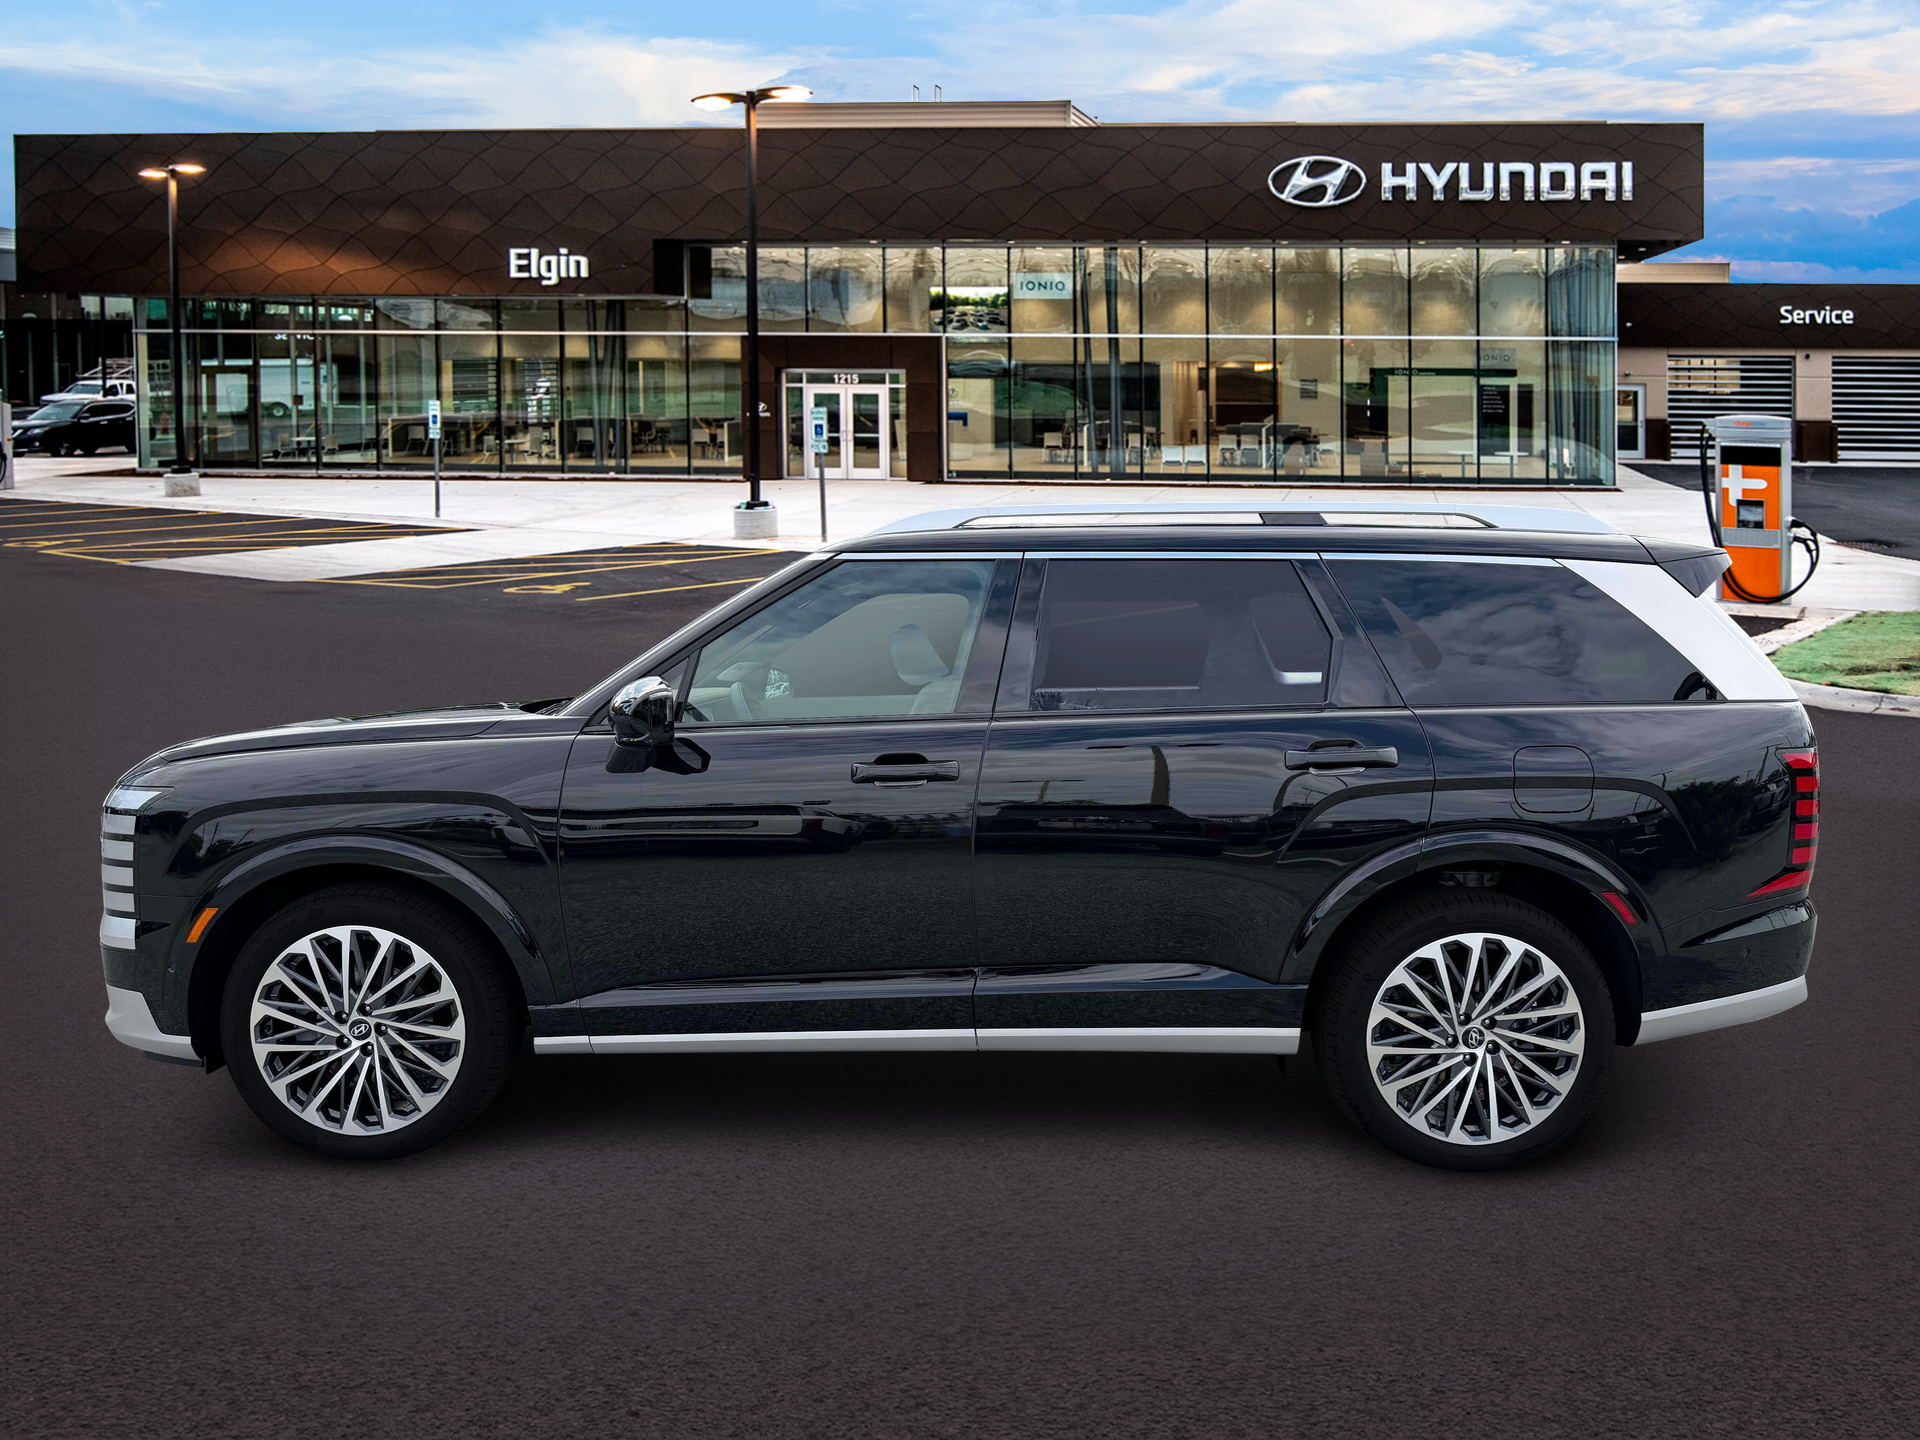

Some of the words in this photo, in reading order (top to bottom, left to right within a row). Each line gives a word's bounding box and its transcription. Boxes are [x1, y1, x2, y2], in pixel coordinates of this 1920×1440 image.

[1381, 161, 1633, 201] HYUNDAI
[509, 248, 589, 285] Elgin
[1020, 281, 1065, 291] IONIQ
[1780, 306, 1854, 324] Service
[833, 373, 859, 384] 1215
